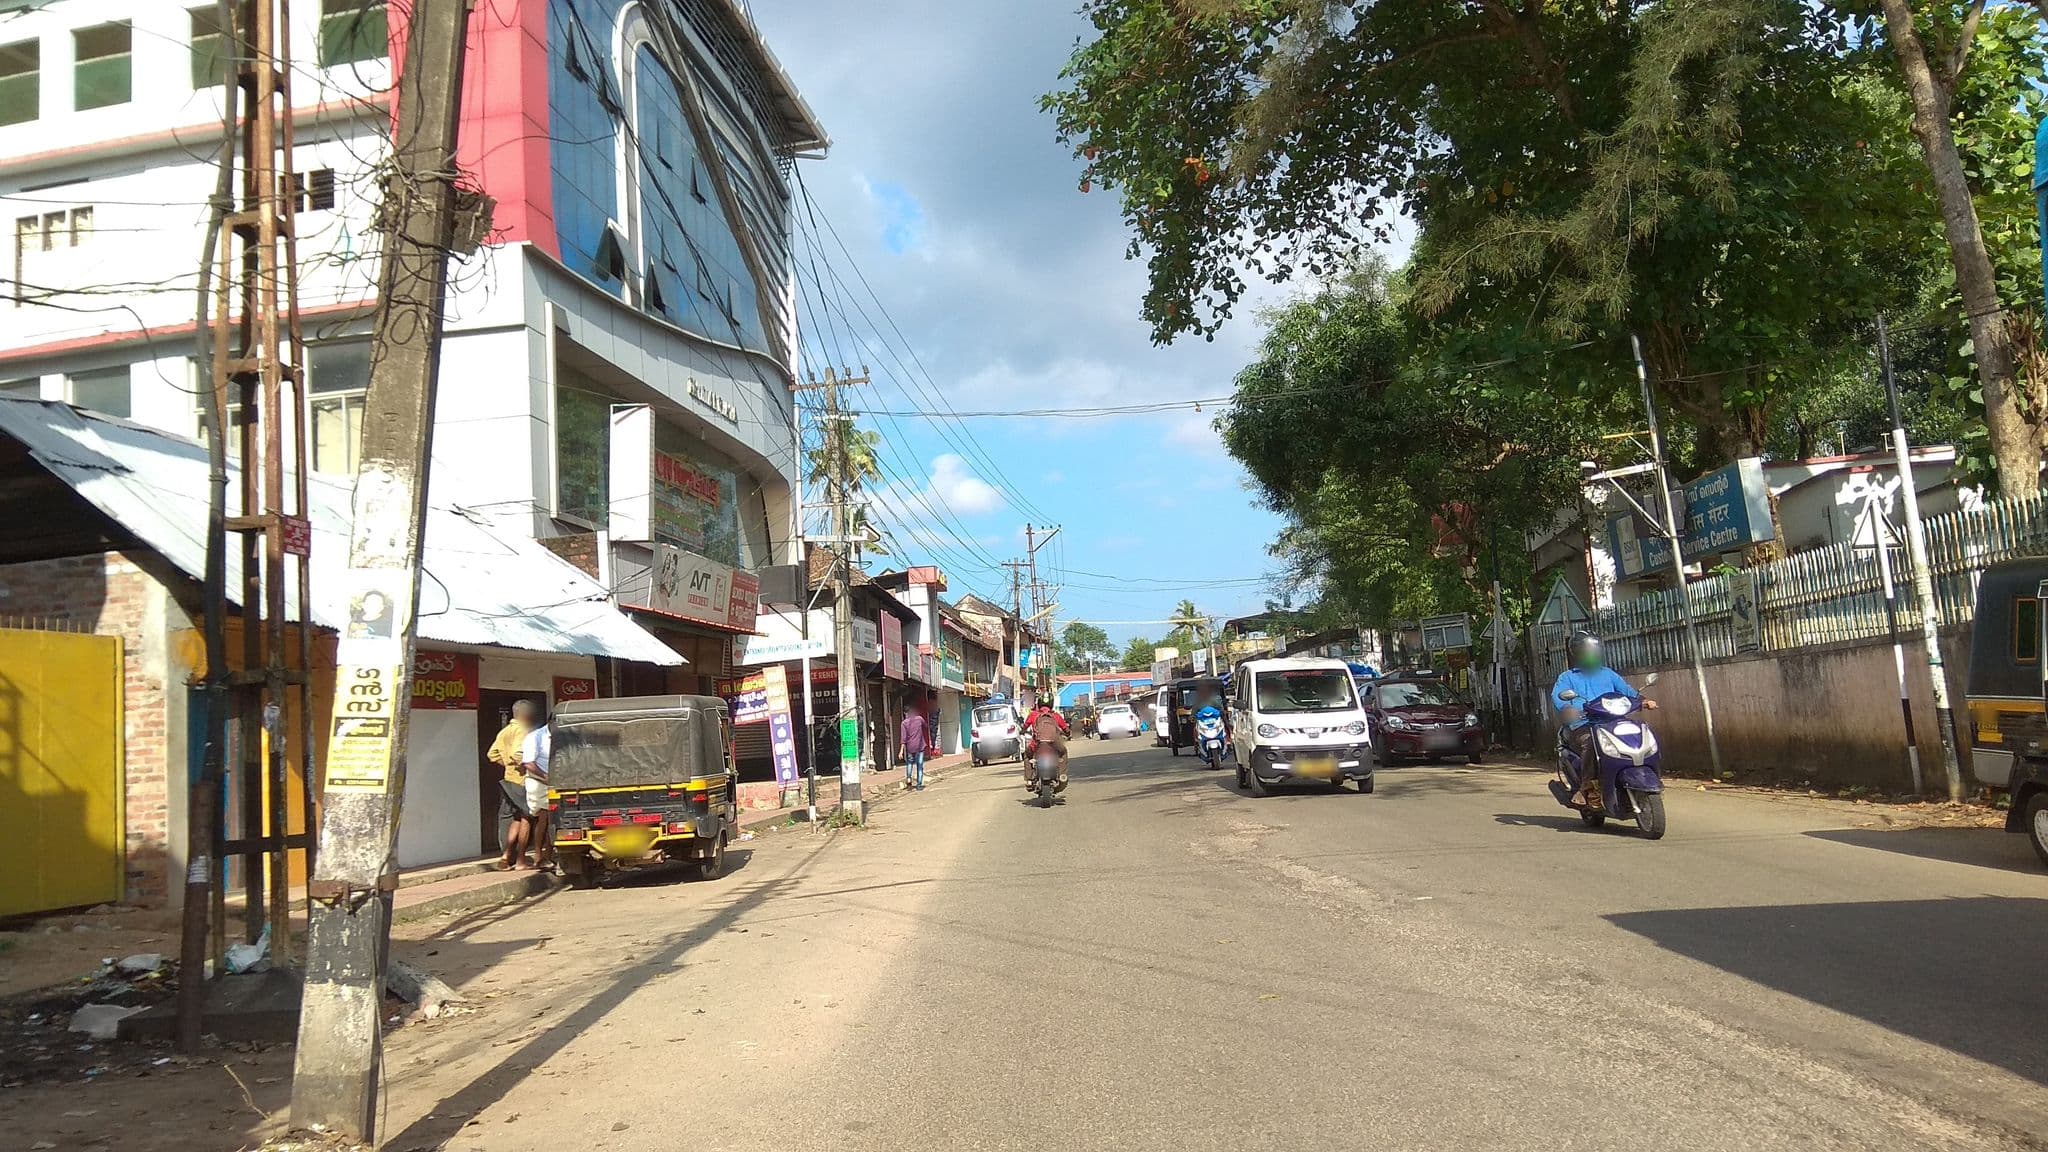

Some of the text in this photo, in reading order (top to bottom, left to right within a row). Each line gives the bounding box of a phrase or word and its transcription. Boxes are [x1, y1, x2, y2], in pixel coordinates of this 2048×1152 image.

[1681, 535, 1710, 556] Service
[1710, 526, 1738, 547] Centre
[690, 569, 712, 593] AVT
